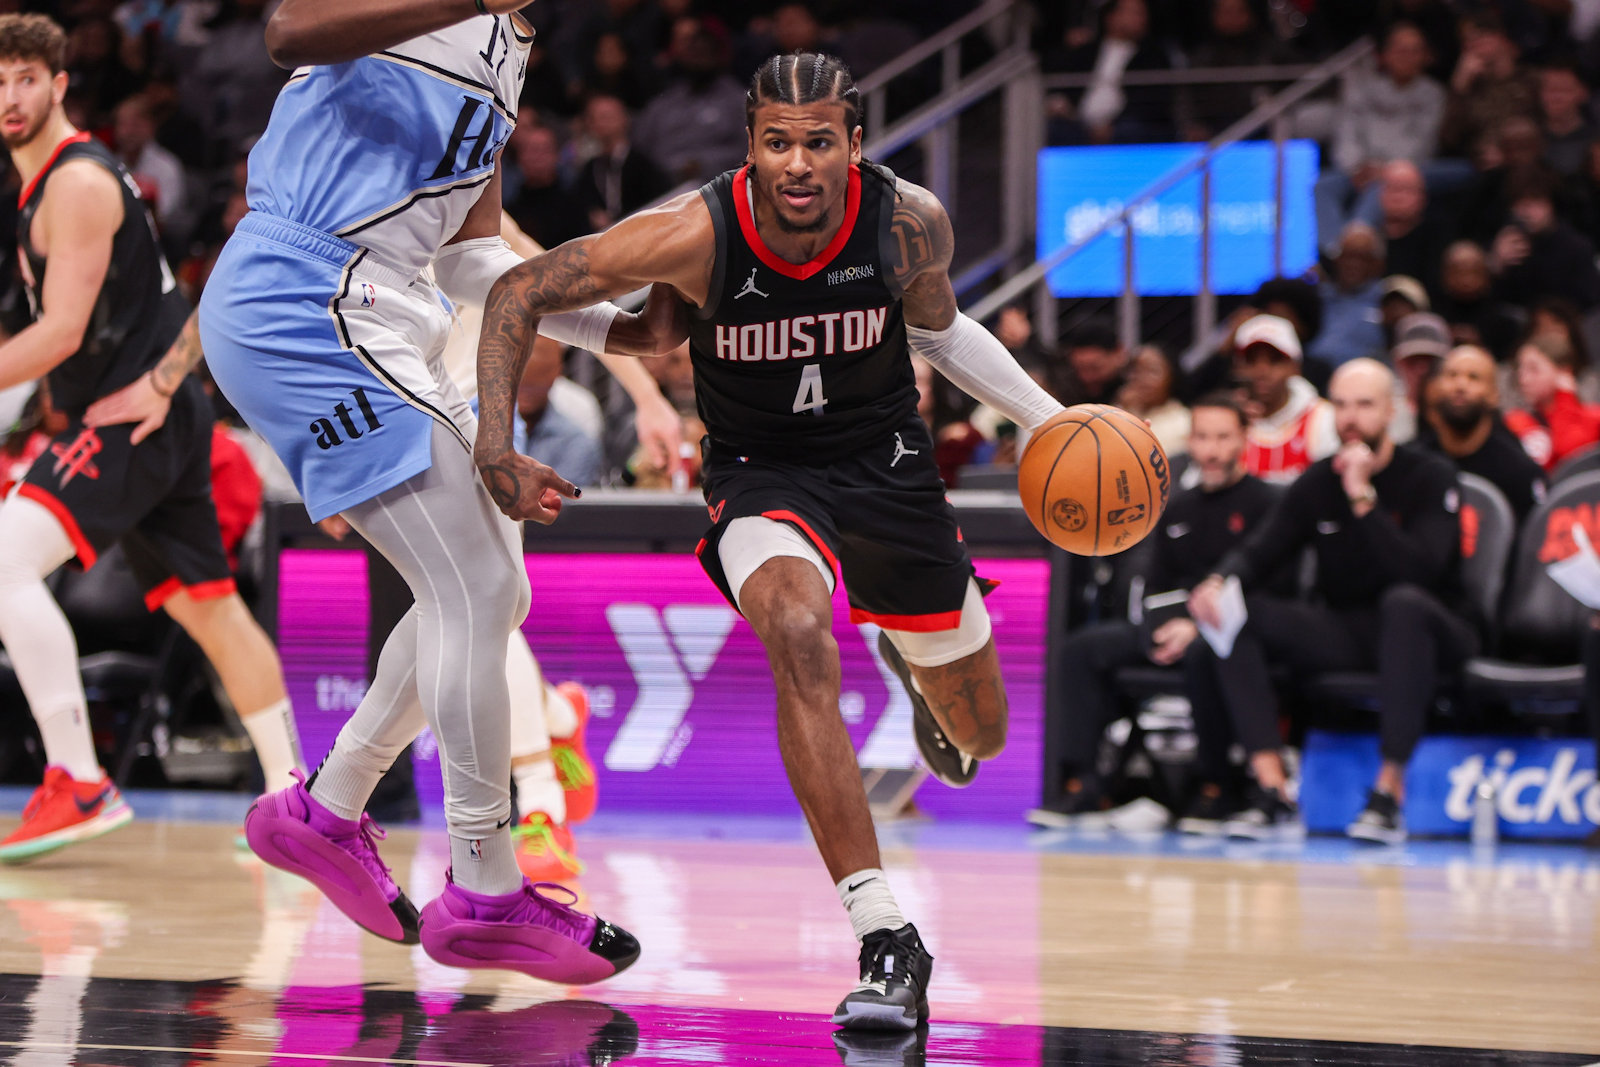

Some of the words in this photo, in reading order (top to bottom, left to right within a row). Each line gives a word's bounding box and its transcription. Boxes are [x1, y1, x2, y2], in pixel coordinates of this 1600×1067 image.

[424, 95, 508, 181] Ha
[827, 264, 873, 280] MEMORIAL
[827, 270, 874, 286] HERMANN
[716, 306, 887, 361] HOUSTON
[792, 363, 828, 416] 4
[309, 386, 385, 450] atl
